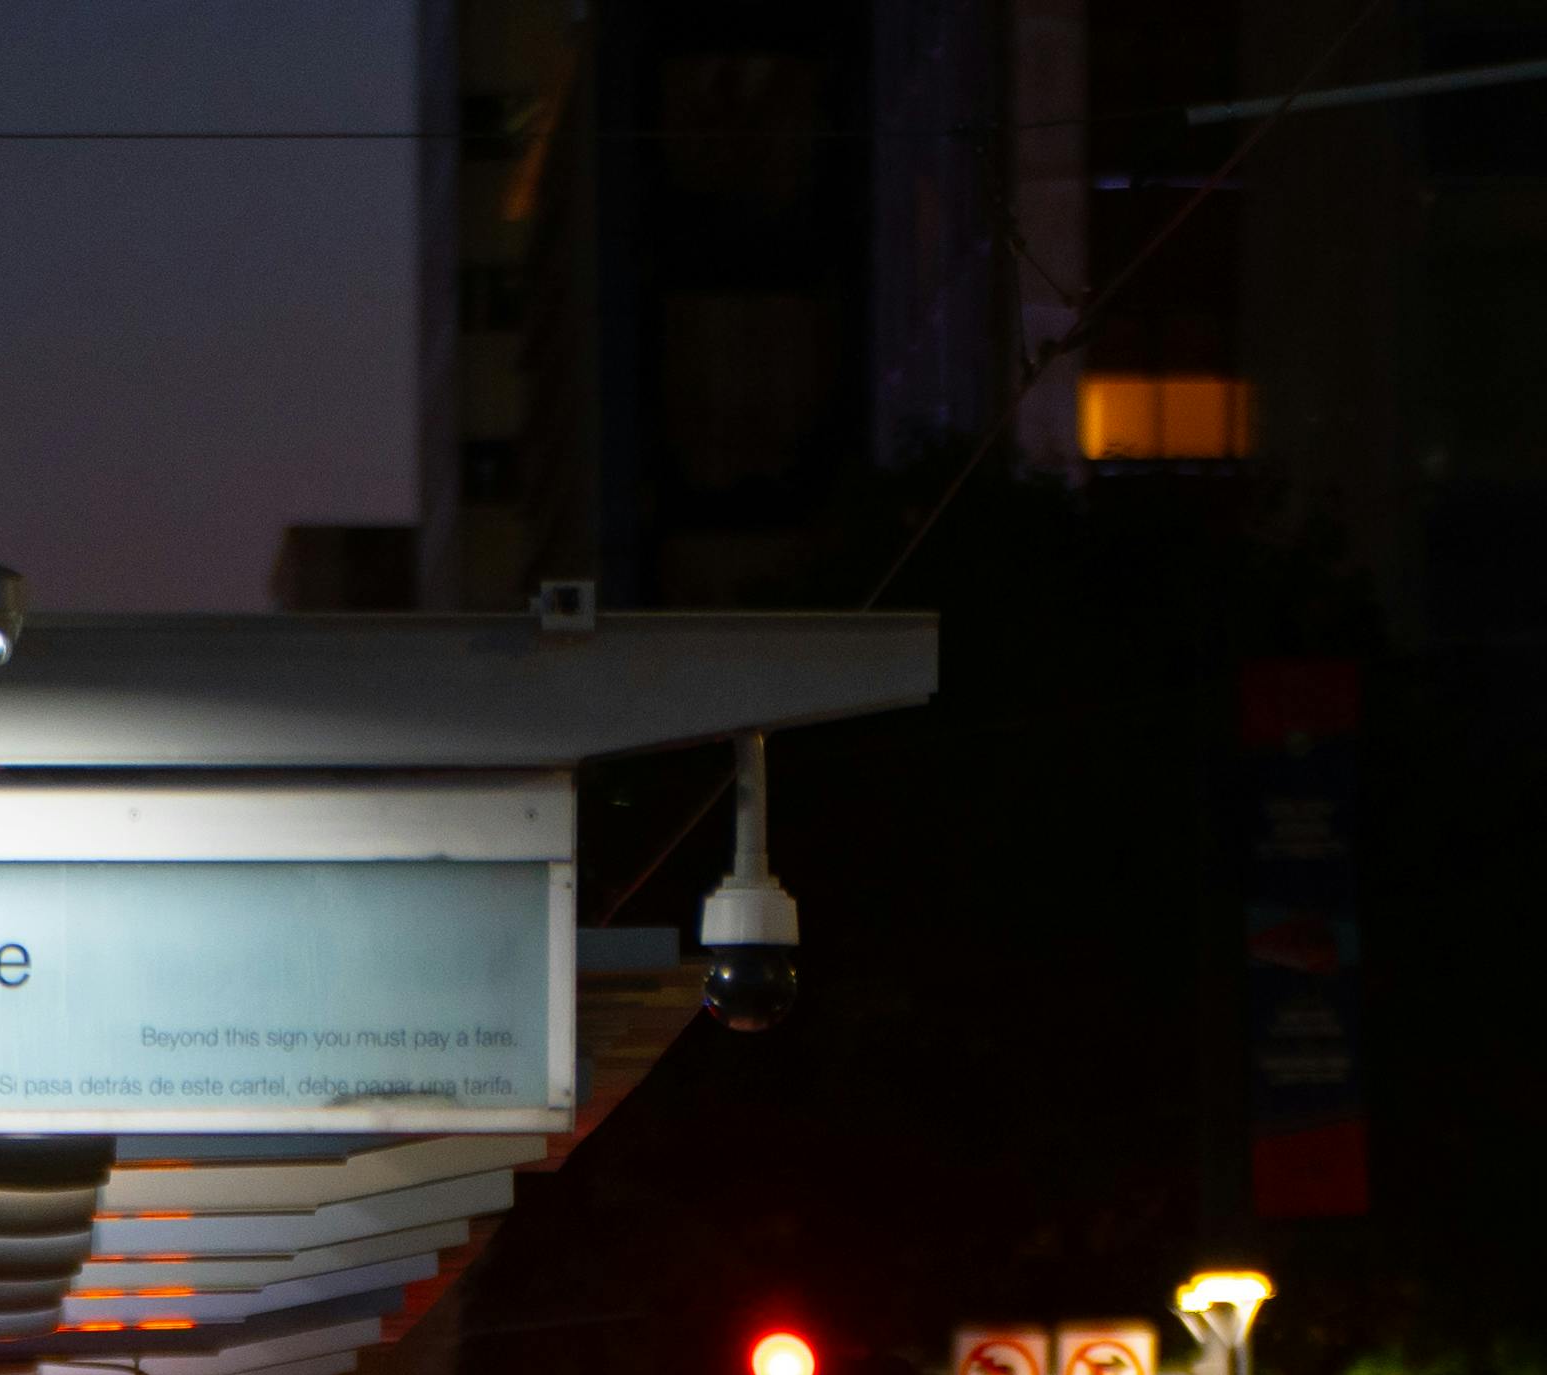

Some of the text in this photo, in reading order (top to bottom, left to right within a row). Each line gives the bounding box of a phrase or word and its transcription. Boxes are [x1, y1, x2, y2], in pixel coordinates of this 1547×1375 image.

[141, 1026, 518, 1050] Beyond this sign you must pay a fare.
[24, 1079, 73, 1099] pasa
[79, 1075, 143, 1096] detrás
[149, 1076, 175, 1096] de
[180, 1078, 224, 1096] este
[298, 1075, 349, 1096] debe
[463, 1075, 518, 1096] tarifa.
